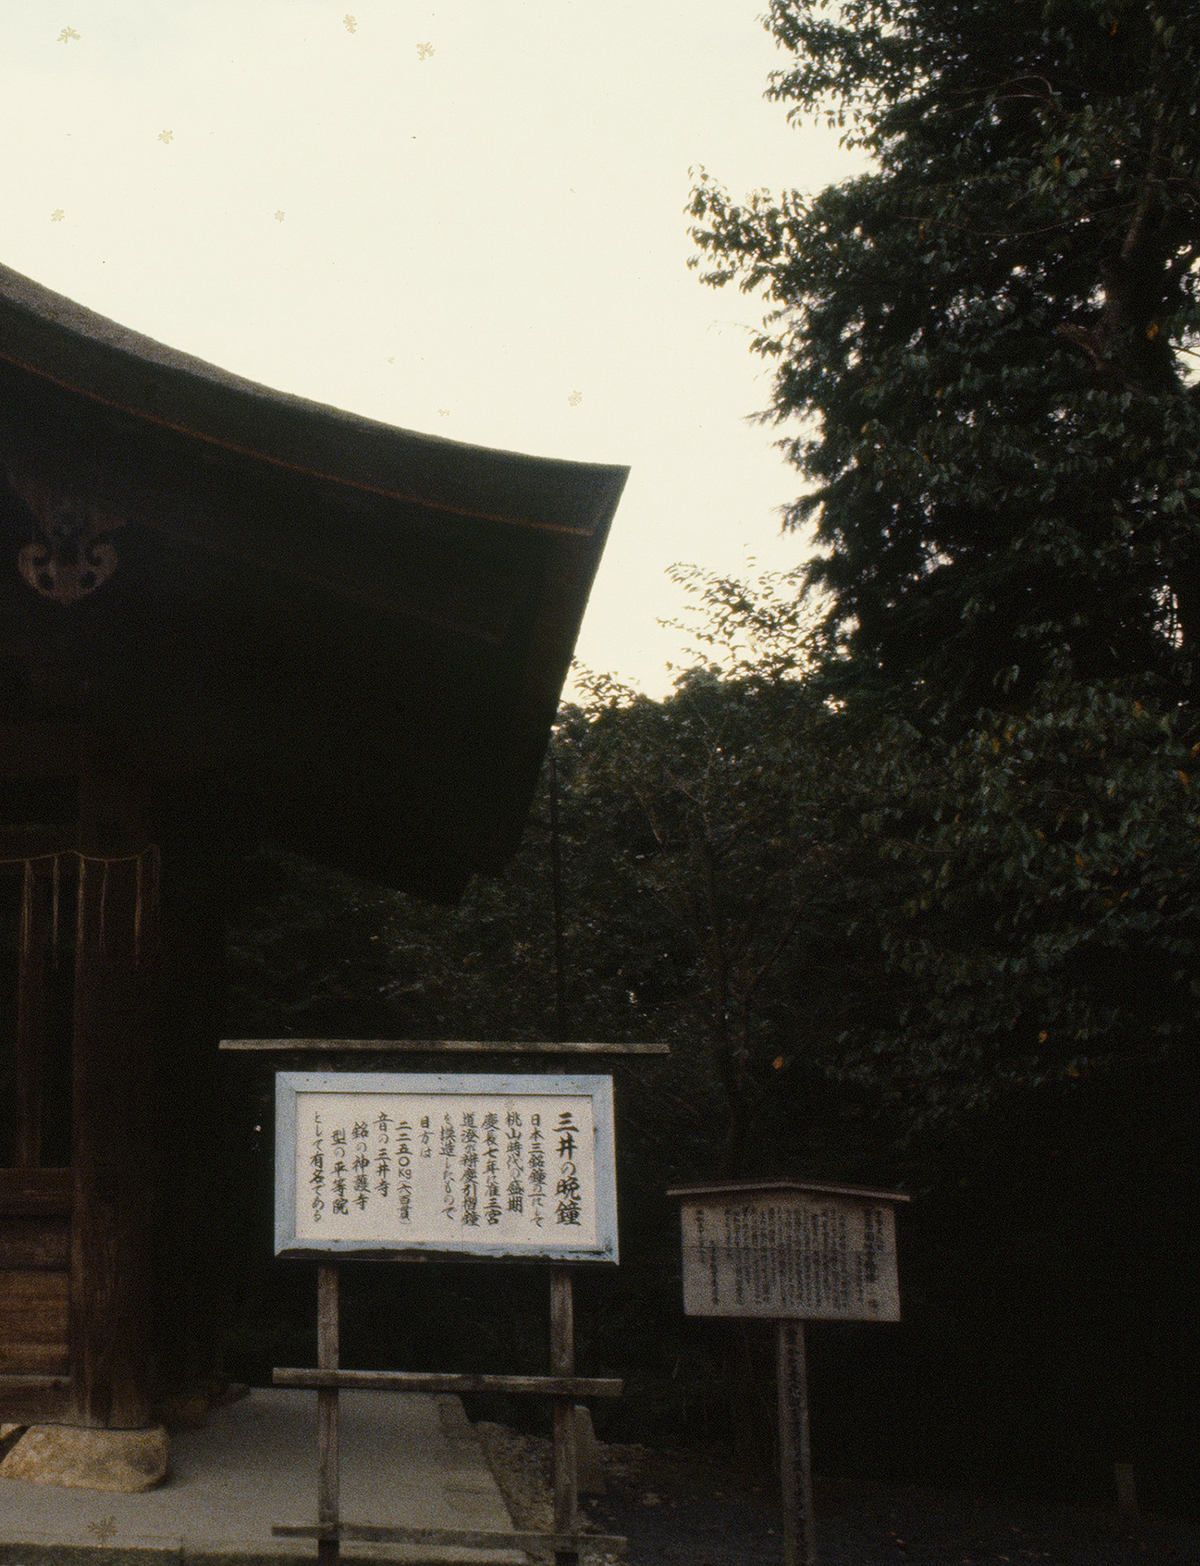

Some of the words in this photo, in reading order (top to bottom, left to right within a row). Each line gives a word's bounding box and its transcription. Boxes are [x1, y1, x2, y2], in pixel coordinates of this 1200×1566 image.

[309, 1111, 325, 1222] として有名である
[330, 1128, 349, 1216] 型の平等院
[352, 1121, 371, 1211] 銘の神護寺
[373, 1111, 393, 1197] 音の三井寺
[418, 1115, 434, 1159] 目方は
[505, 1111, 524, 1213] 桃山時代の盛期
[552, 1112, 582, 1226] 三井の晩鐘
